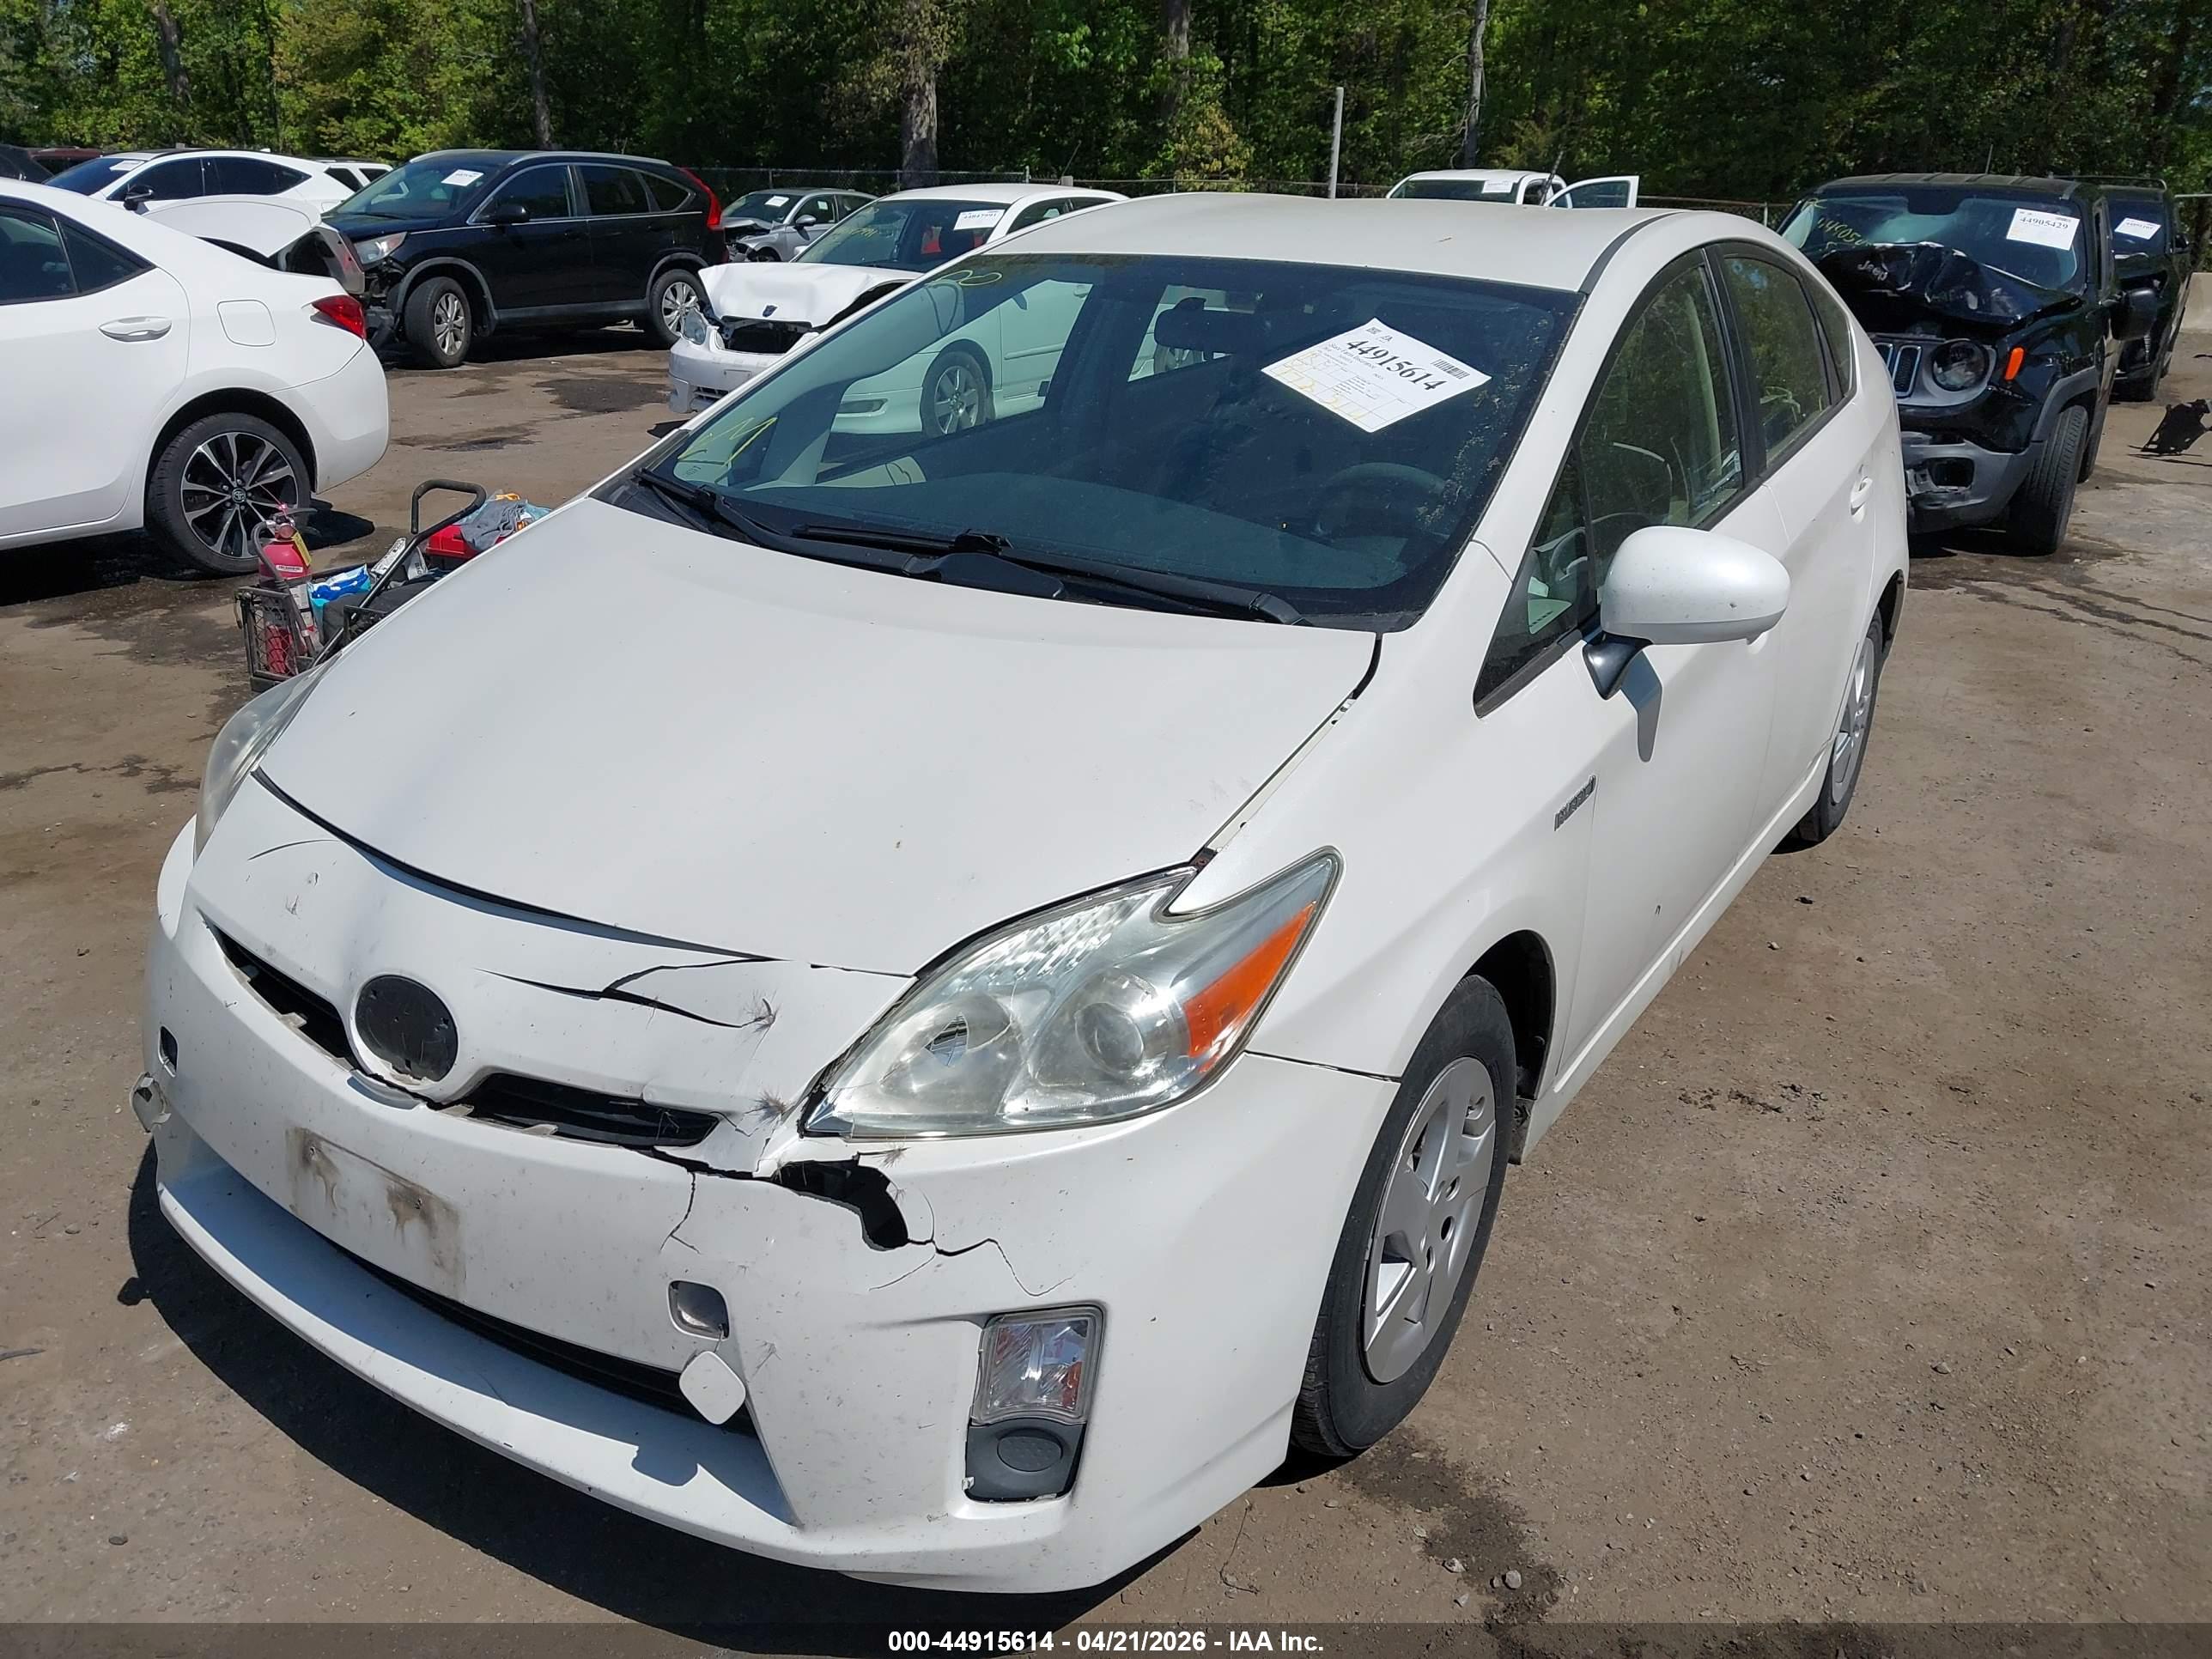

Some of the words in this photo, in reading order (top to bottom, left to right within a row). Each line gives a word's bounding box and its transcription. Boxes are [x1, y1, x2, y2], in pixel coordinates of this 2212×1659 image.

[2019, 216, 2069, 230] 44905429
[1857, 260, 1888, 281] Jeep
[1346, 340, 1448, 390] 44915614
